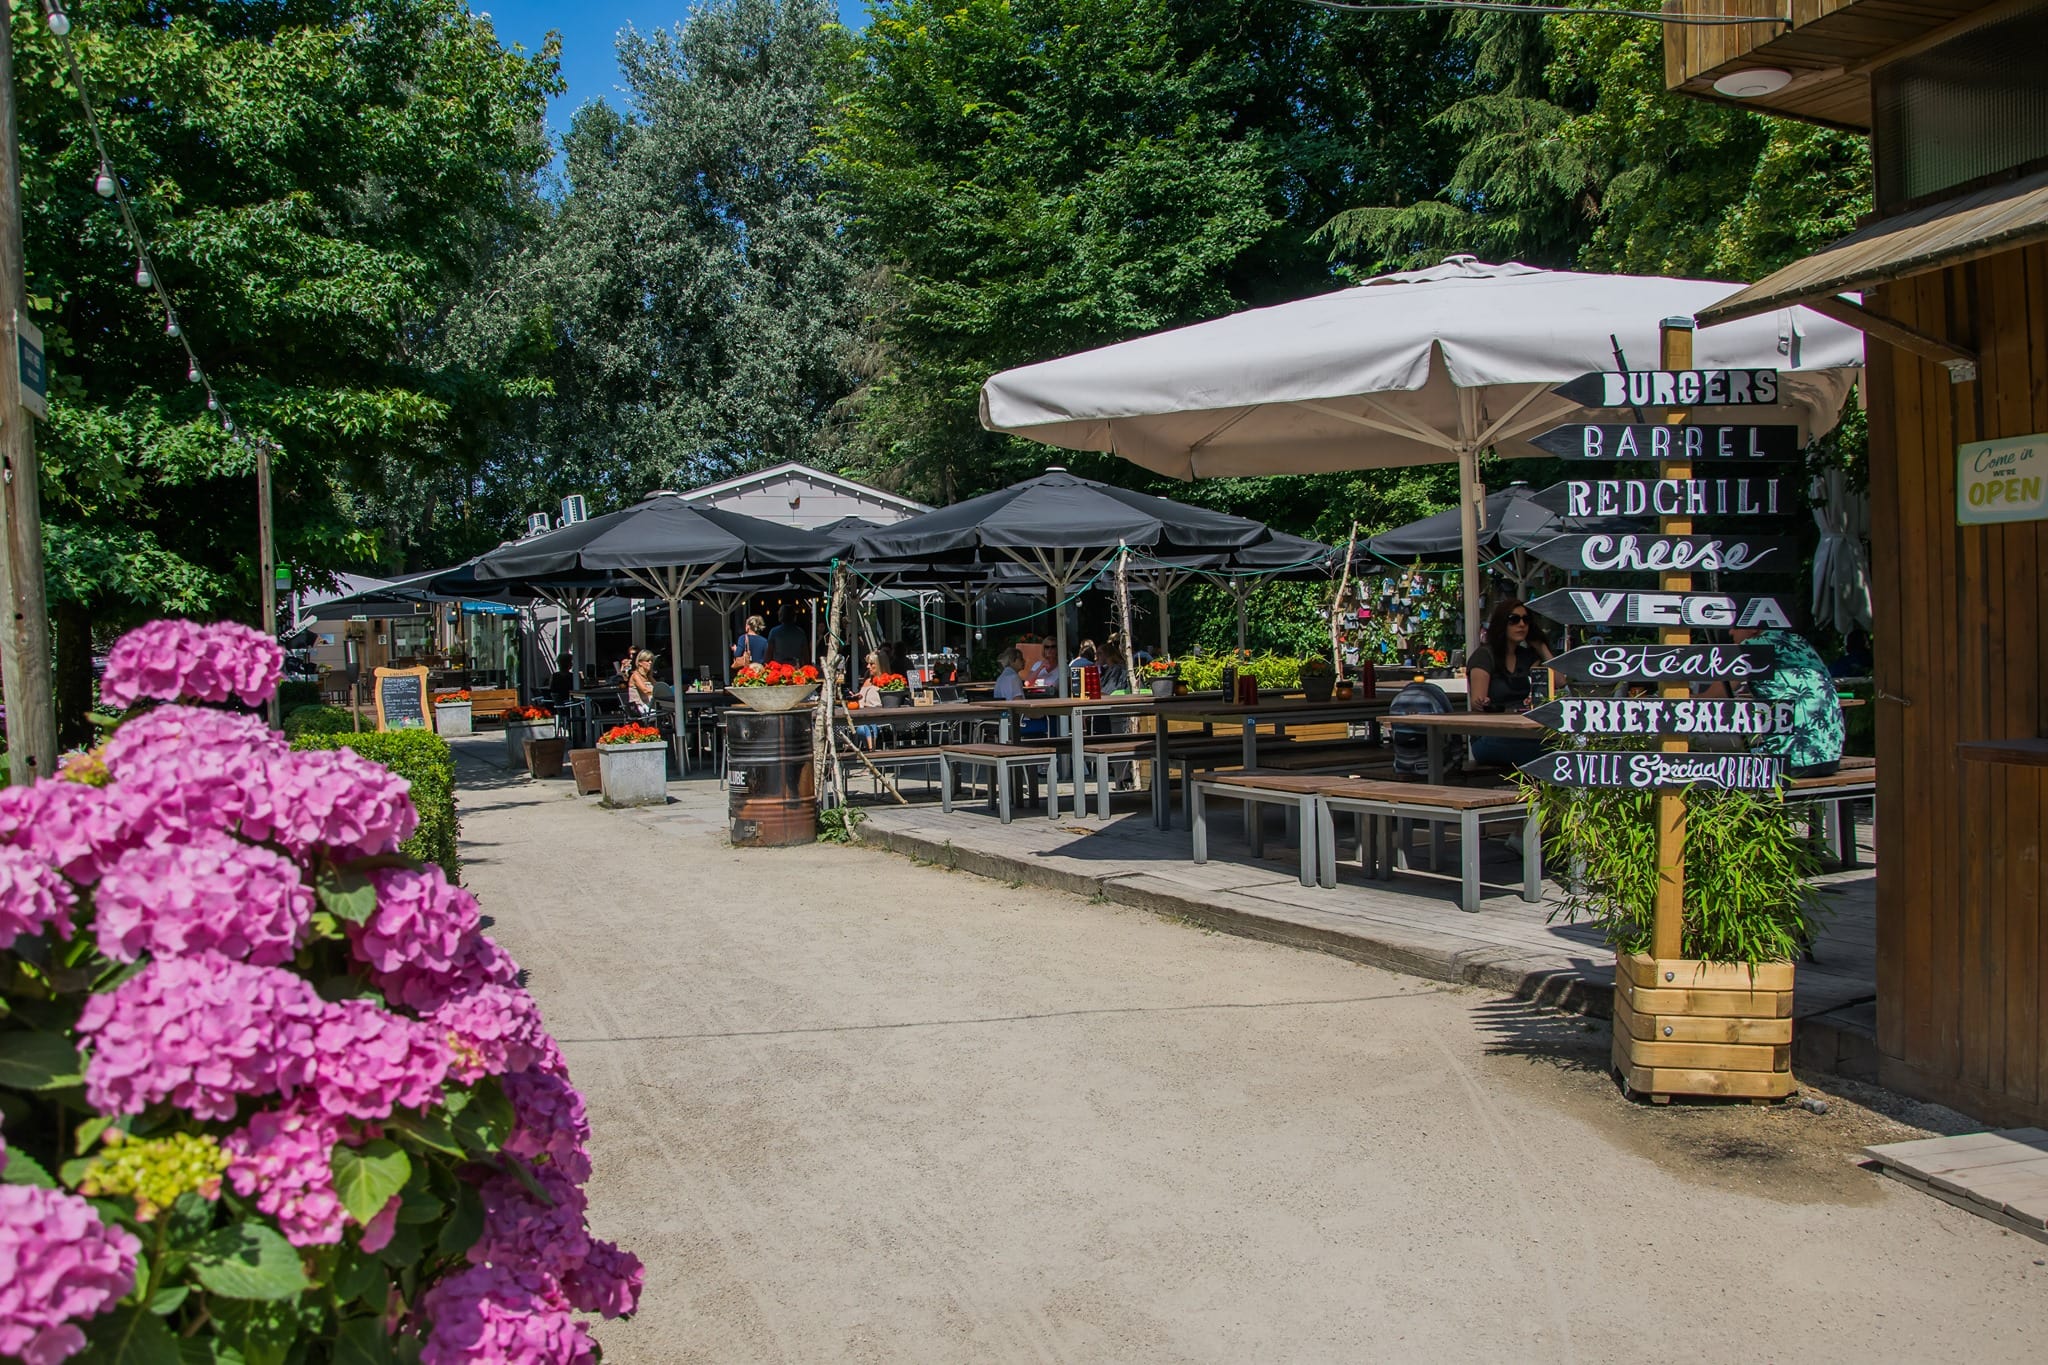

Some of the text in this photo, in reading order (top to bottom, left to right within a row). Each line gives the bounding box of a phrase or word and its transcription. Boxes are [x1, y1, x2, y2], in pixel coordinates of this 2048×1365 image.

[1603, 371, 1777, 406] BURGERS
[1583, 426, 1766, 457] BARREL
[1974, 447, 2034, 473] Come in
[1993, 468, 2016, 476] WE'RE
[1567, 479, 1778, 516] REDCHILI
[1968, 476, 2041, 506] OPEN
[1581, 535, 1778, 571] Cheese
[1568, 592, 1793, 628] VEGA
[1588, 646, 1771, 678] Steaks
[1553, 756, 1573, 782] &
[1576, 755, 1622, 786] VELE
[1727, 756, 1785, 789] BIEREN
